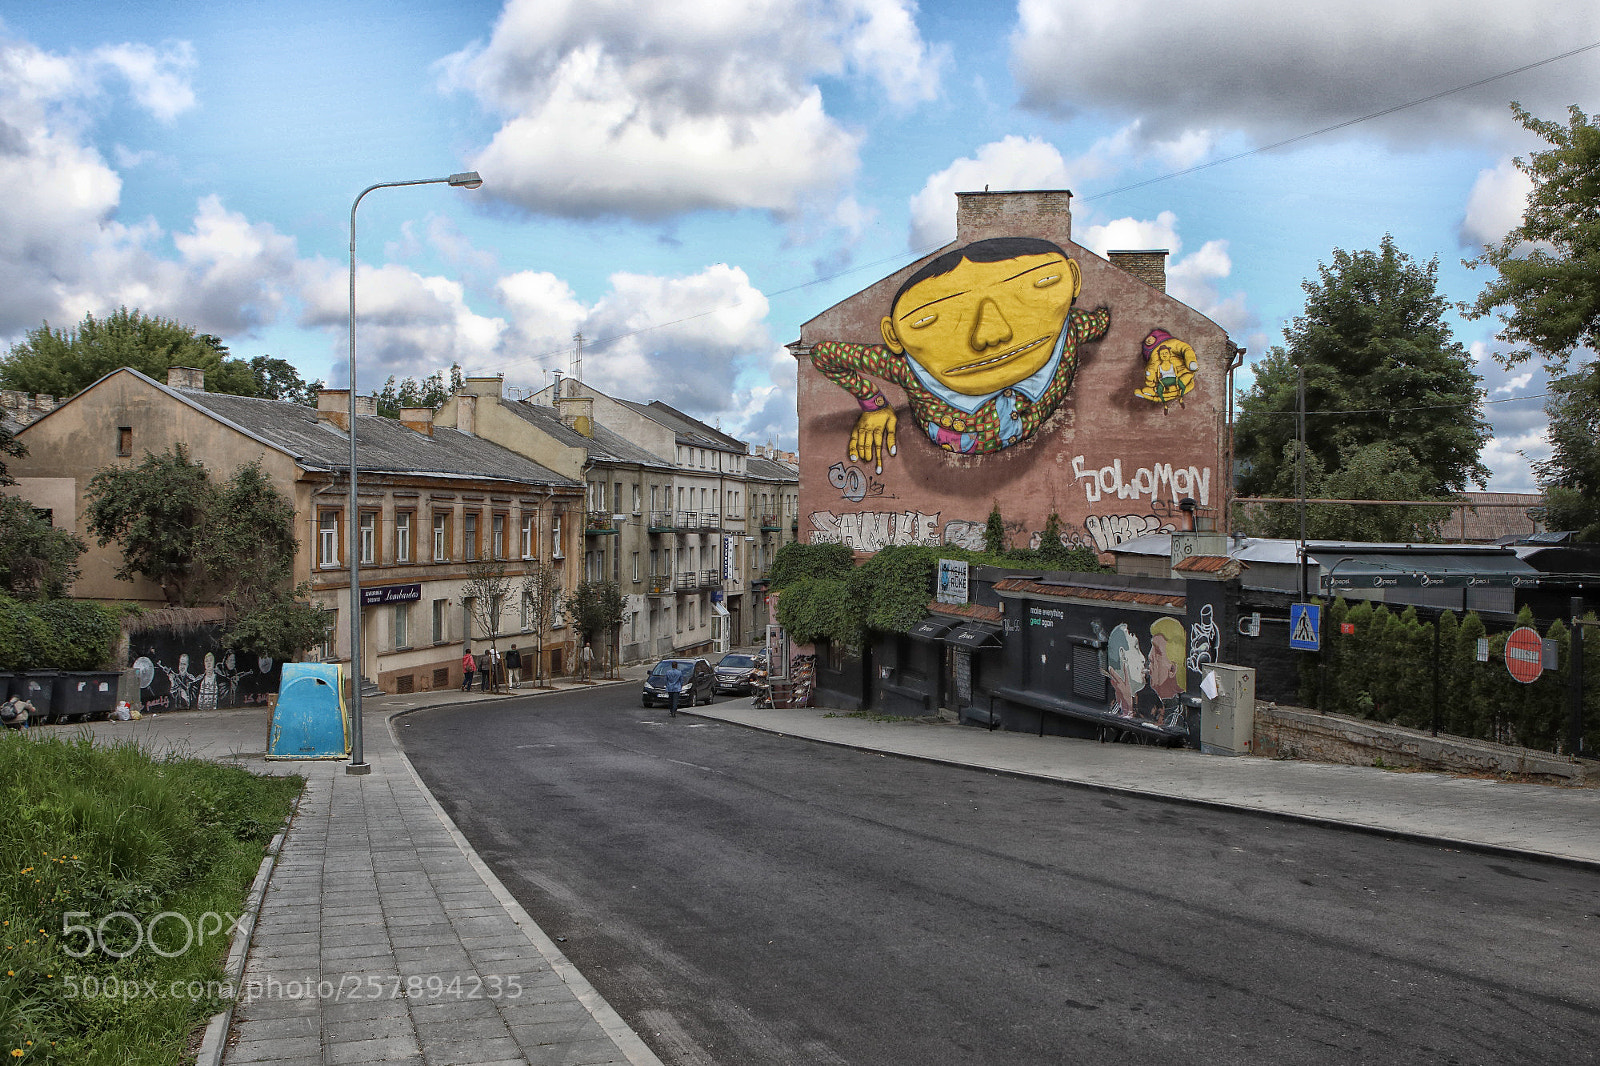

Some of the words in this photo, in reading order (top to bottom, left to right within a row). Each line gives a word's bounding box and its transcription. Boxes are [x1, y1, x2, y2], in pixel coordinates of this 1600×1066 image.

[1071, 454, 1211, 506] SOLOMON
[1029, 606, 1042, 615] make
[1042, 608, 1064, 620] everything
[1029, 617, 1041, 626] great
[1041, 618, 1054, 628] again
